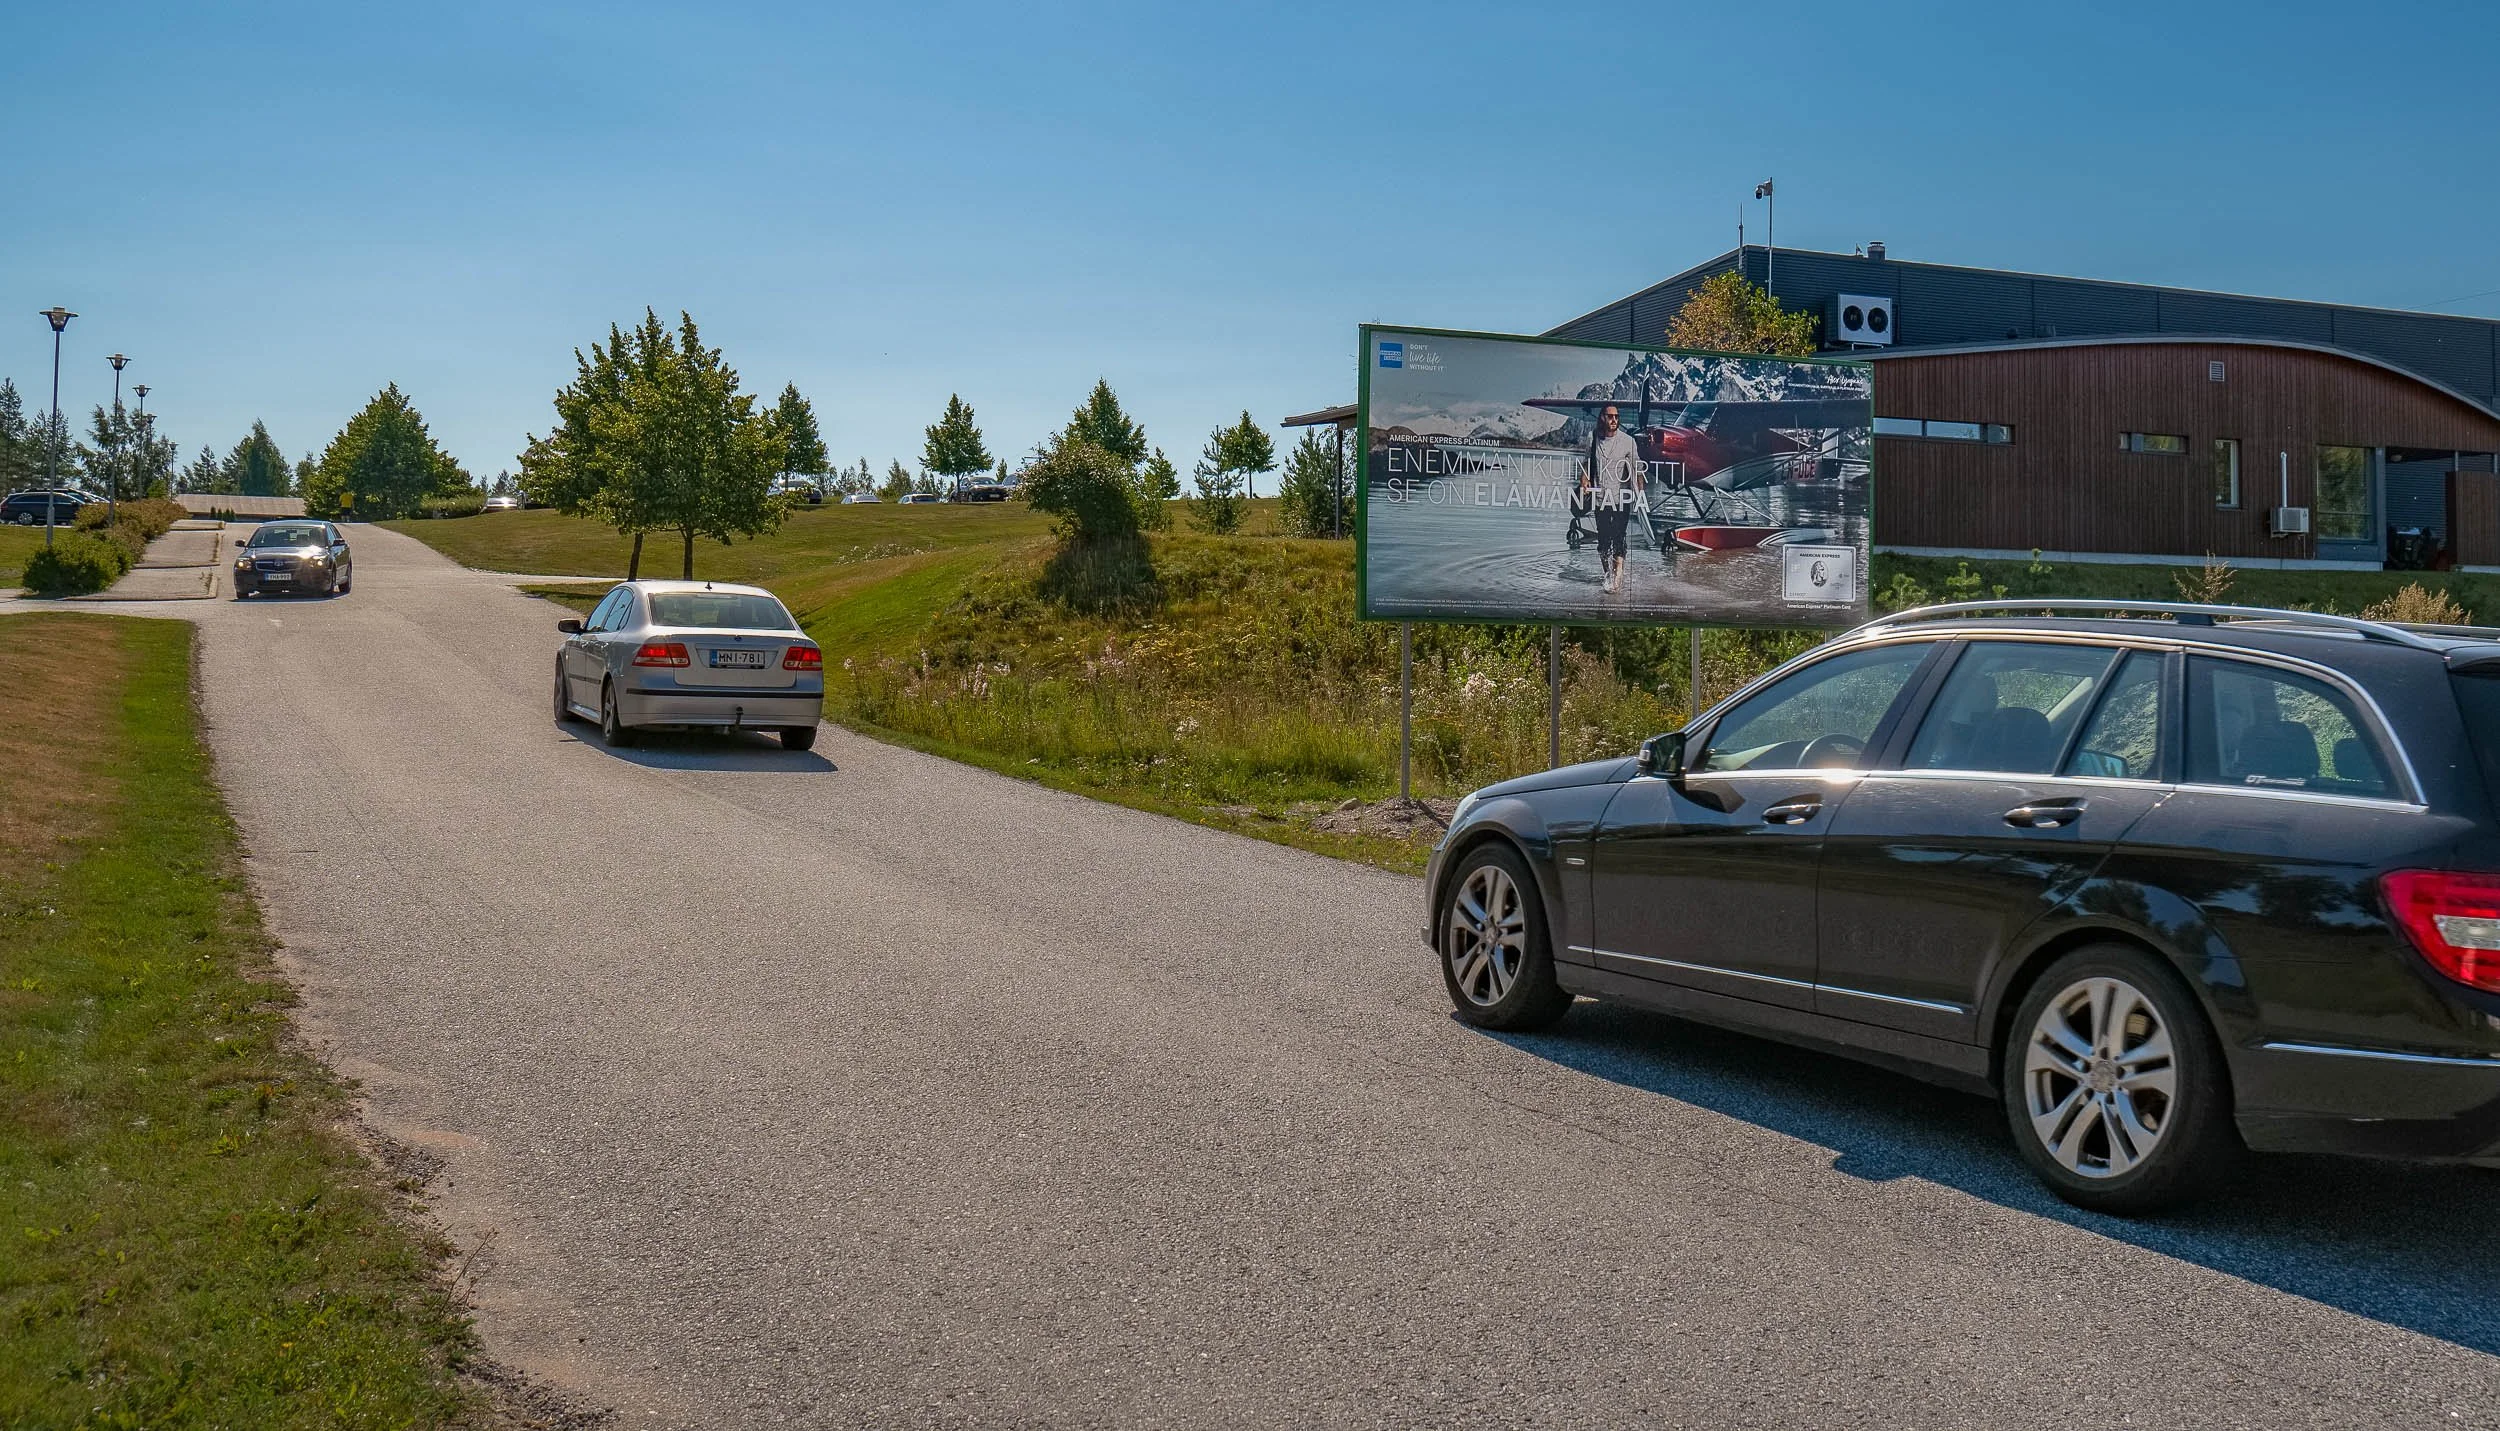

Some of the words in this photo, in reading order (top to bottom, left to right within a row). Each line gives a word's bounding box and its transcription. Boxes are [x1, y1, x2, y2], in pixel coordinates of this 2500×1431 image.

[1409, 351, 1425, 362] live
[1426, 352, 1441, 364] life
[1409, 363, 1436, 371] WITHOUT
[1389, 434, 1428, 443] AMERICAN
[1429, 436, 1463, 445] EXPRESS
[1463, 438, 1500, 447] PLATINUM
[1388, 447, 1524, 477] ENEMMÄN
[1532, 454, 1591, 482] KUIN
[1599, 459, 1685, 485] KORTTI
[1387, 478, 1420, 503] SE
[1428, 479, 1466, 505] ON
[1474, 479, 1650, 513] ELÄMÄNTAPA
[719, 652, 760, 663] MNI-781
